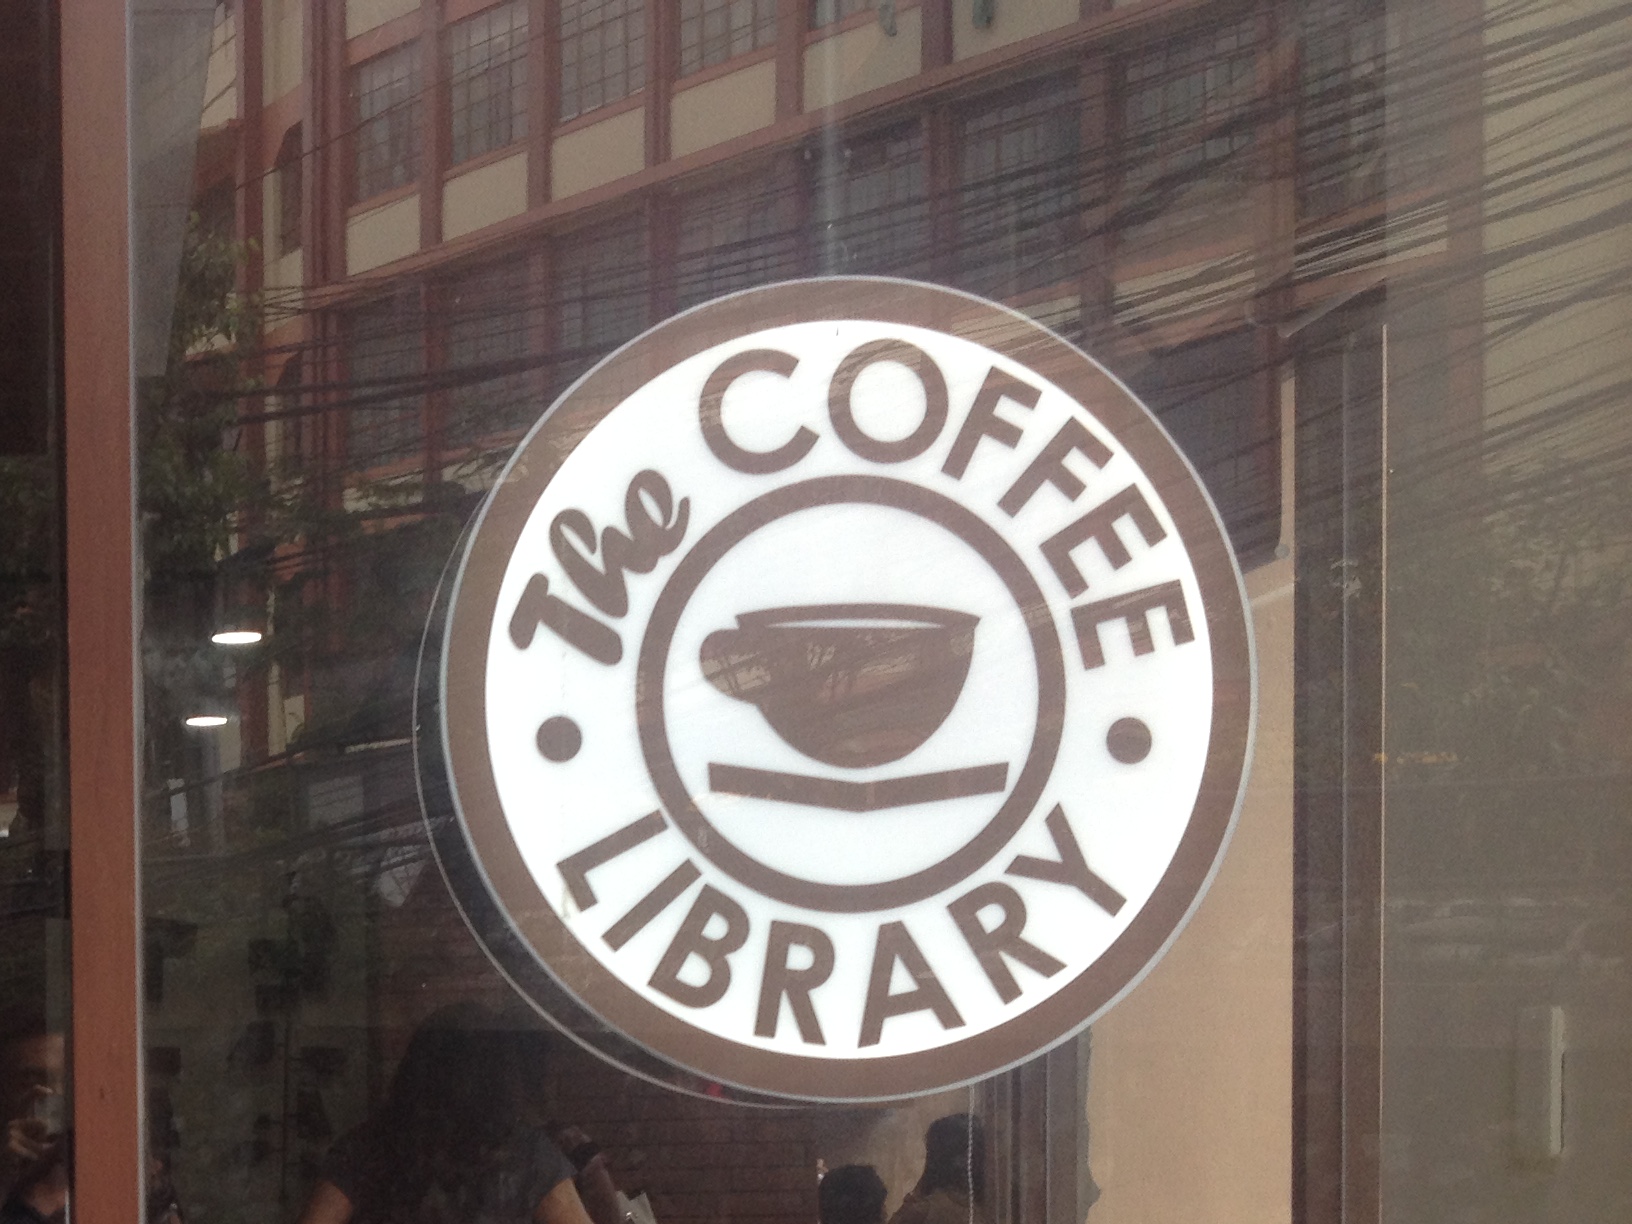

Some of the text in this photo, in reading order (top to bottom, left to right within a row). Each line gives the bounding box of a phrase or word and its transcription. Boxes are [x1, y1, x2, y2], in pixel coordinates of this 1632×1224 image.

[508, 337, 1196, 672] The COFFEE
[555, 802, 1128, 1049] LIBRARY
